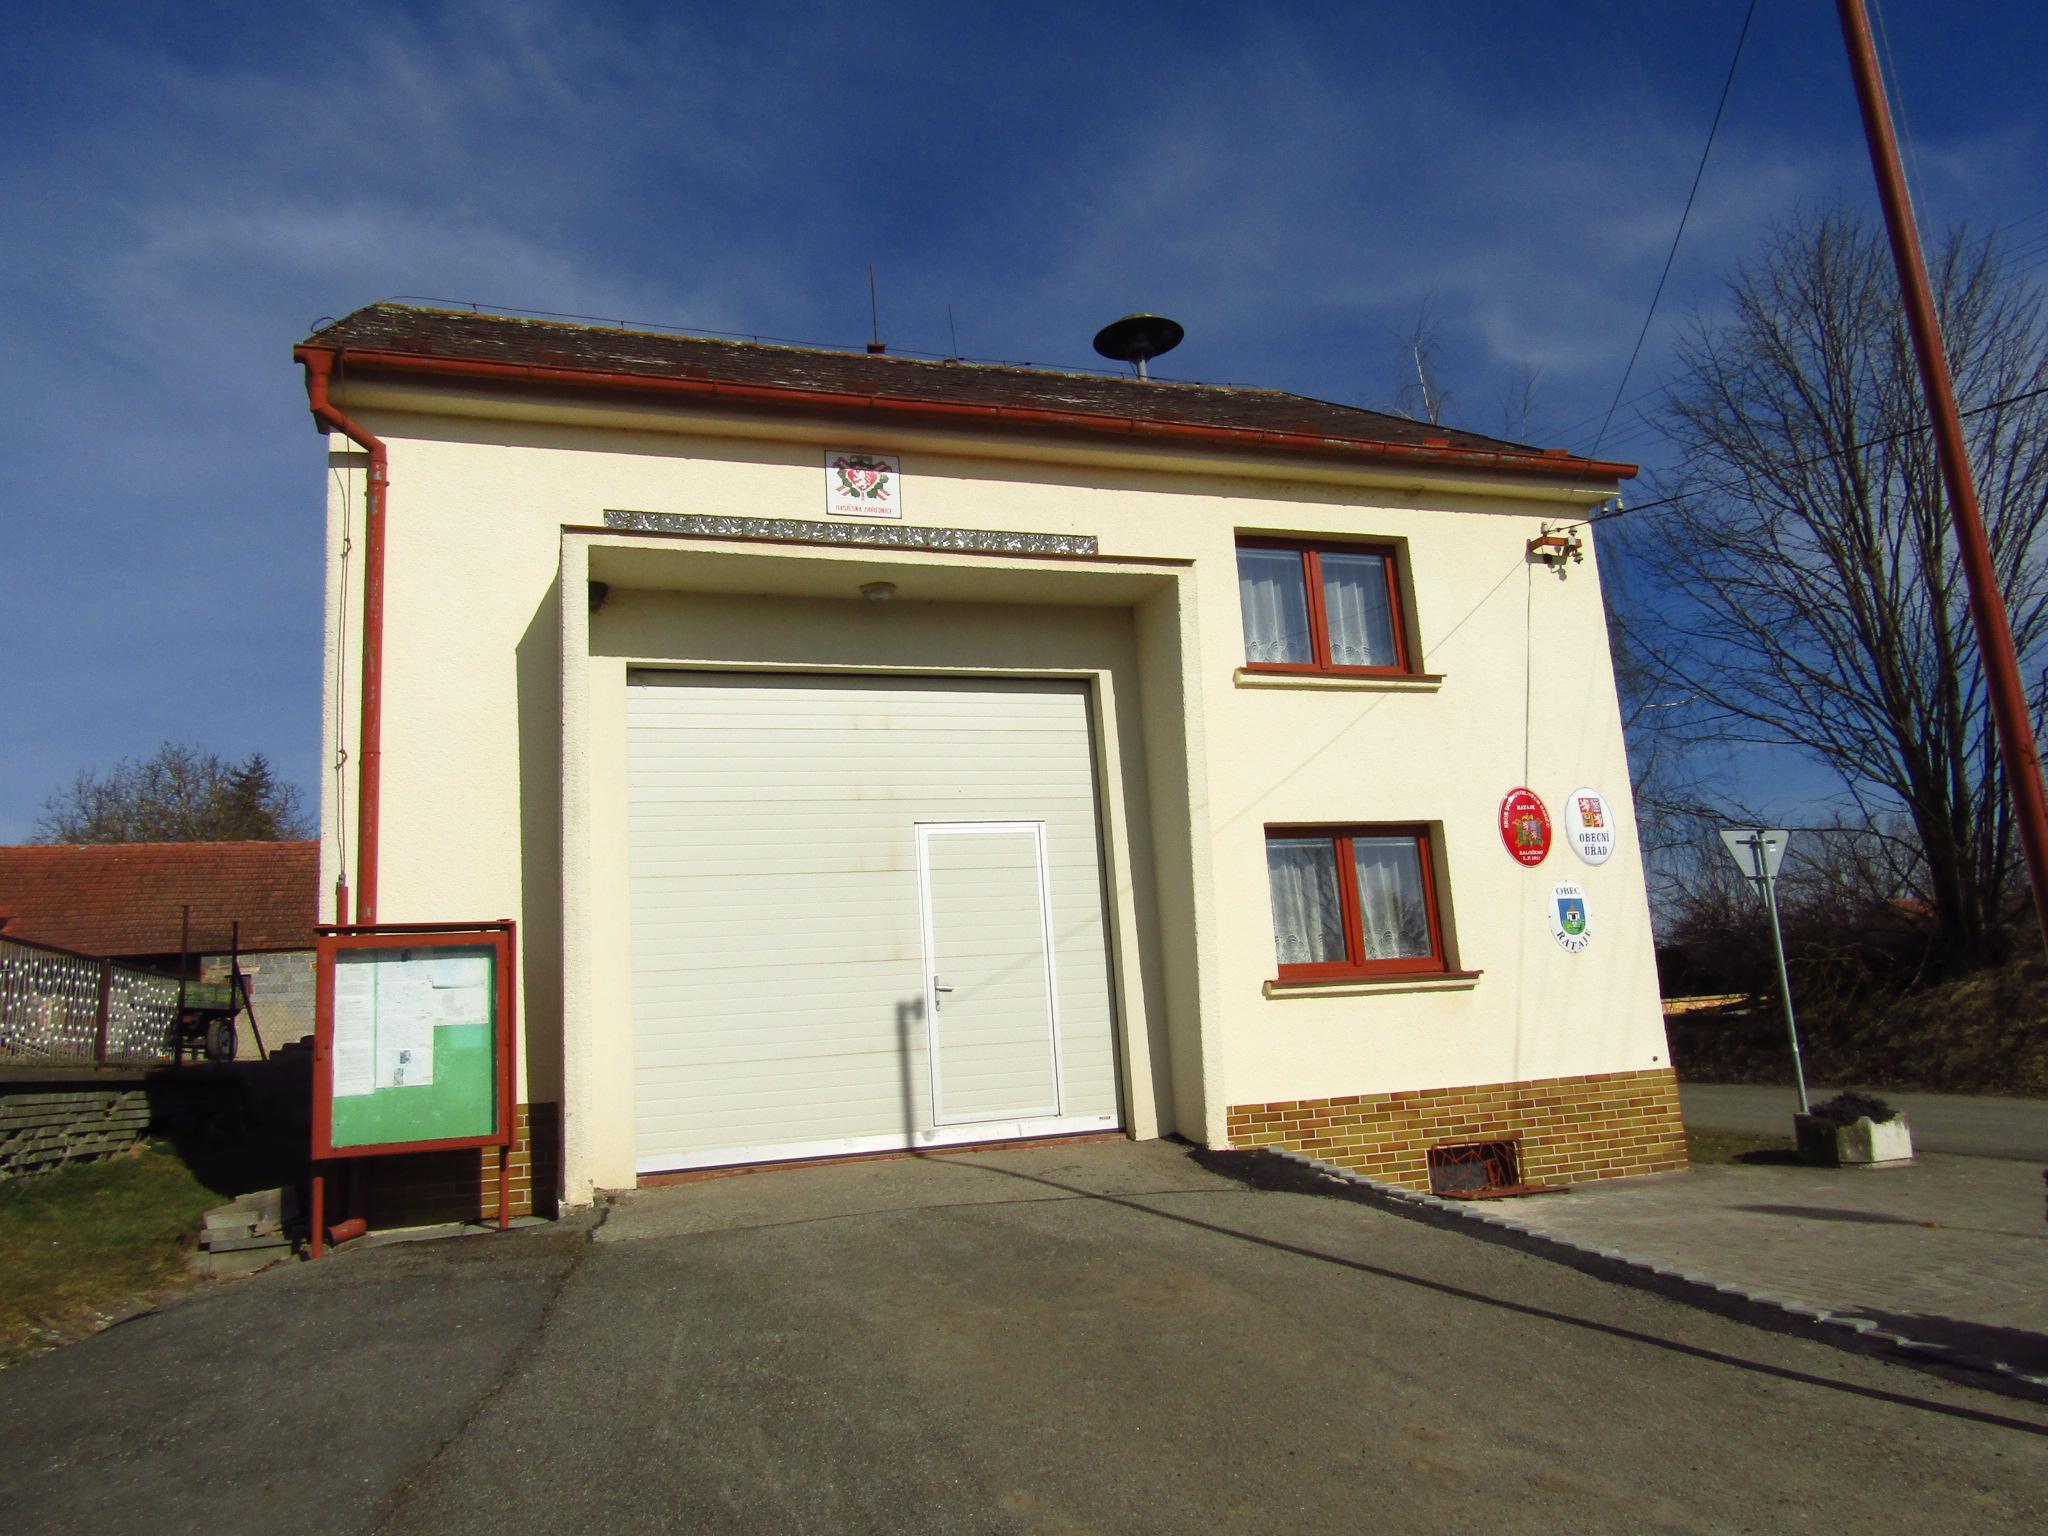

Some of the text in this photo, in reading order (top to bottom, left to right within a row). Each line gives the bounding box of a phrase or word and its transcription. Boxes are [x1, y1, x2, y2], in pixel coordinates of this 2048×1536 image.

[1579, 830, 1610, 843] OBECNÍ
[1584, 844, 1608, 856] ÚŘAD
[1555, 886, 1580, 895] OBEC
[1556, 929, 1592, 951] RATAJE
